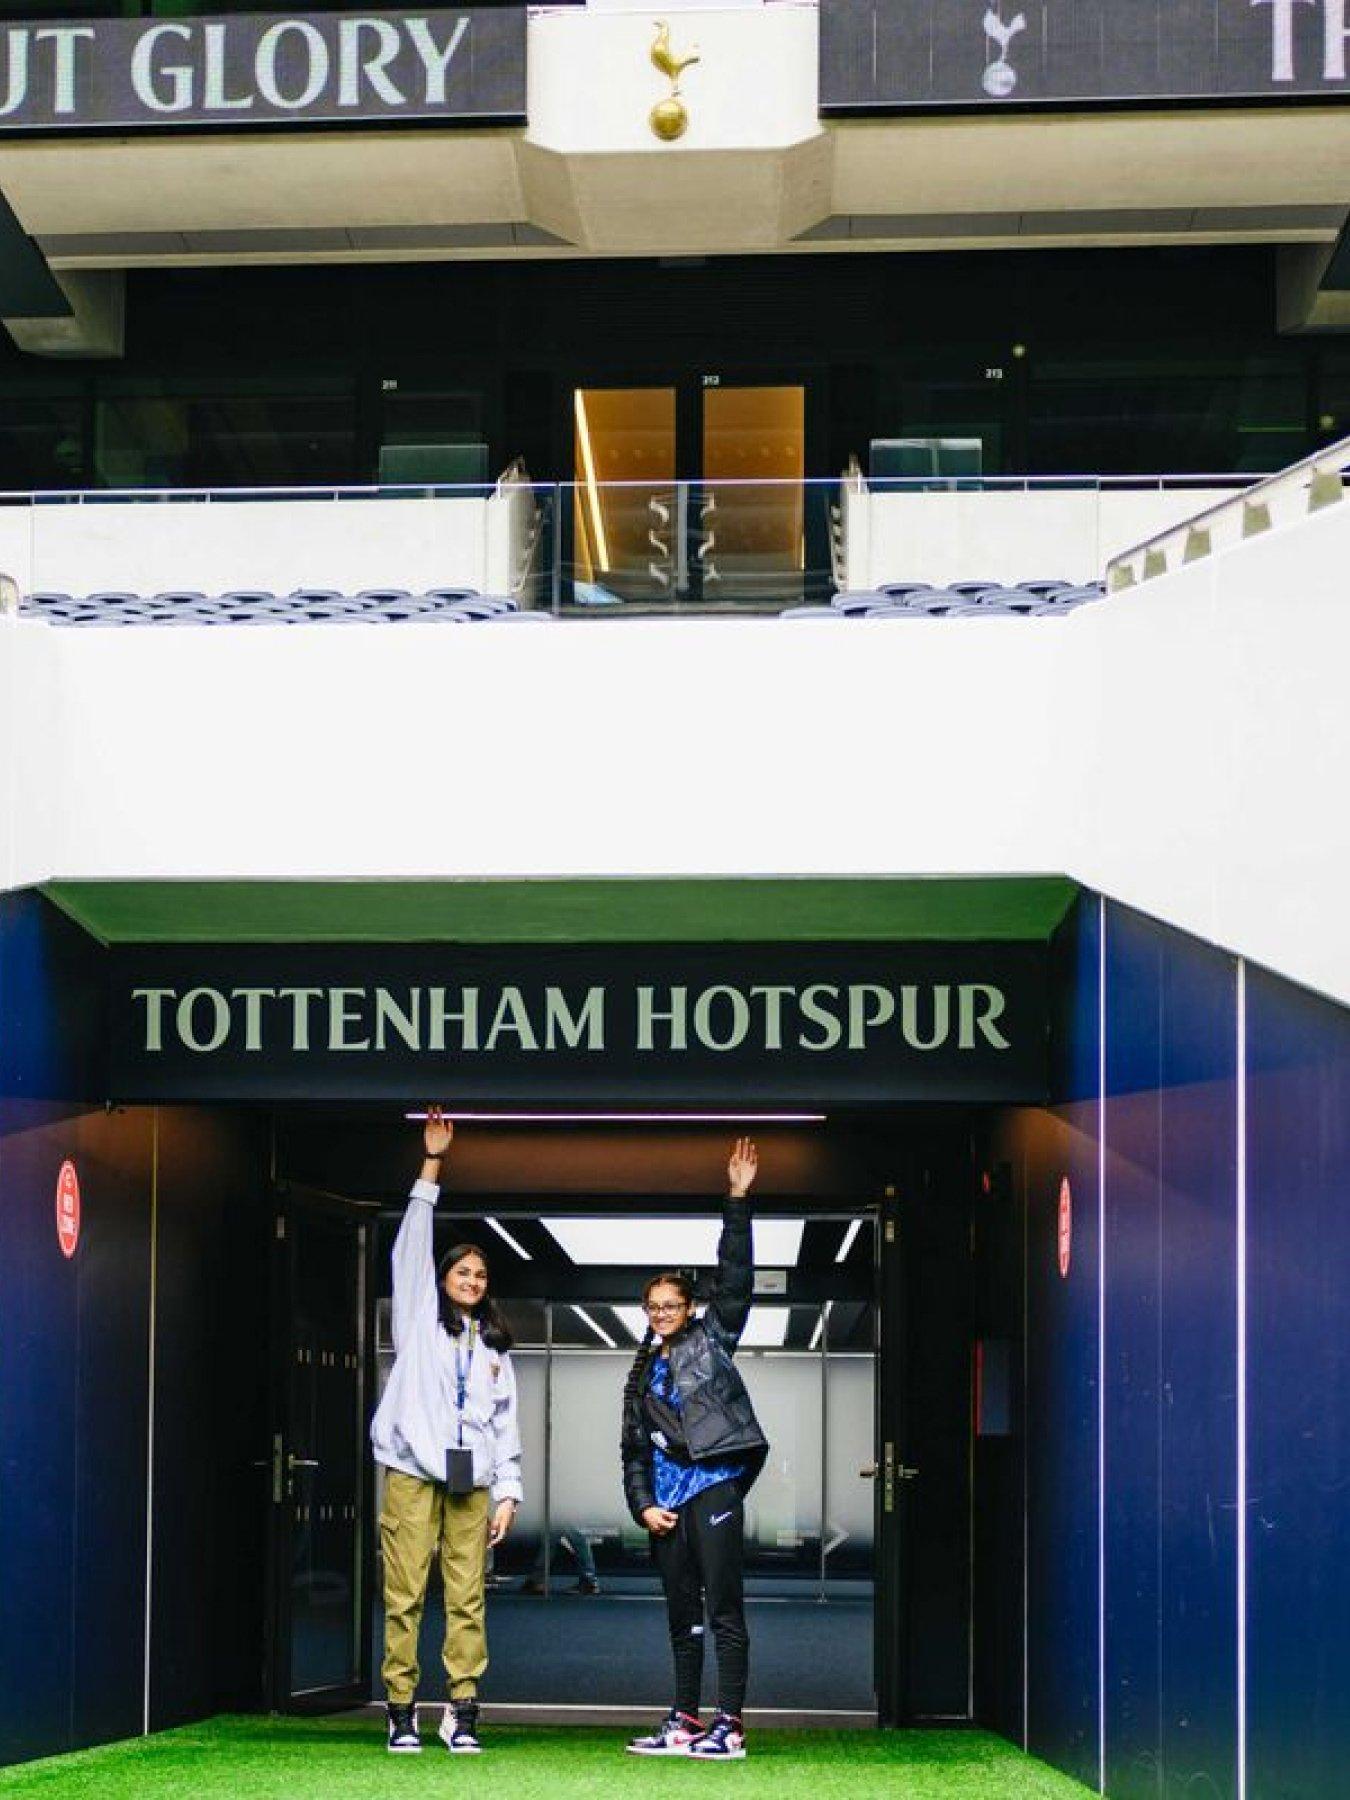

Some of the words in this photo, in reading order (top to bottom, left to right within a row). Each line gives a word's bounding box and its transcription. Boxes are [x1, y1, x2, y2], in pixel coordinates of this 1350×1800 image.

[130, 17, 470, 113] GLORY
[132, 986, 605, 1052] TOTTENHAM
[636, 984, 1010, 1051] HOTSPUR
